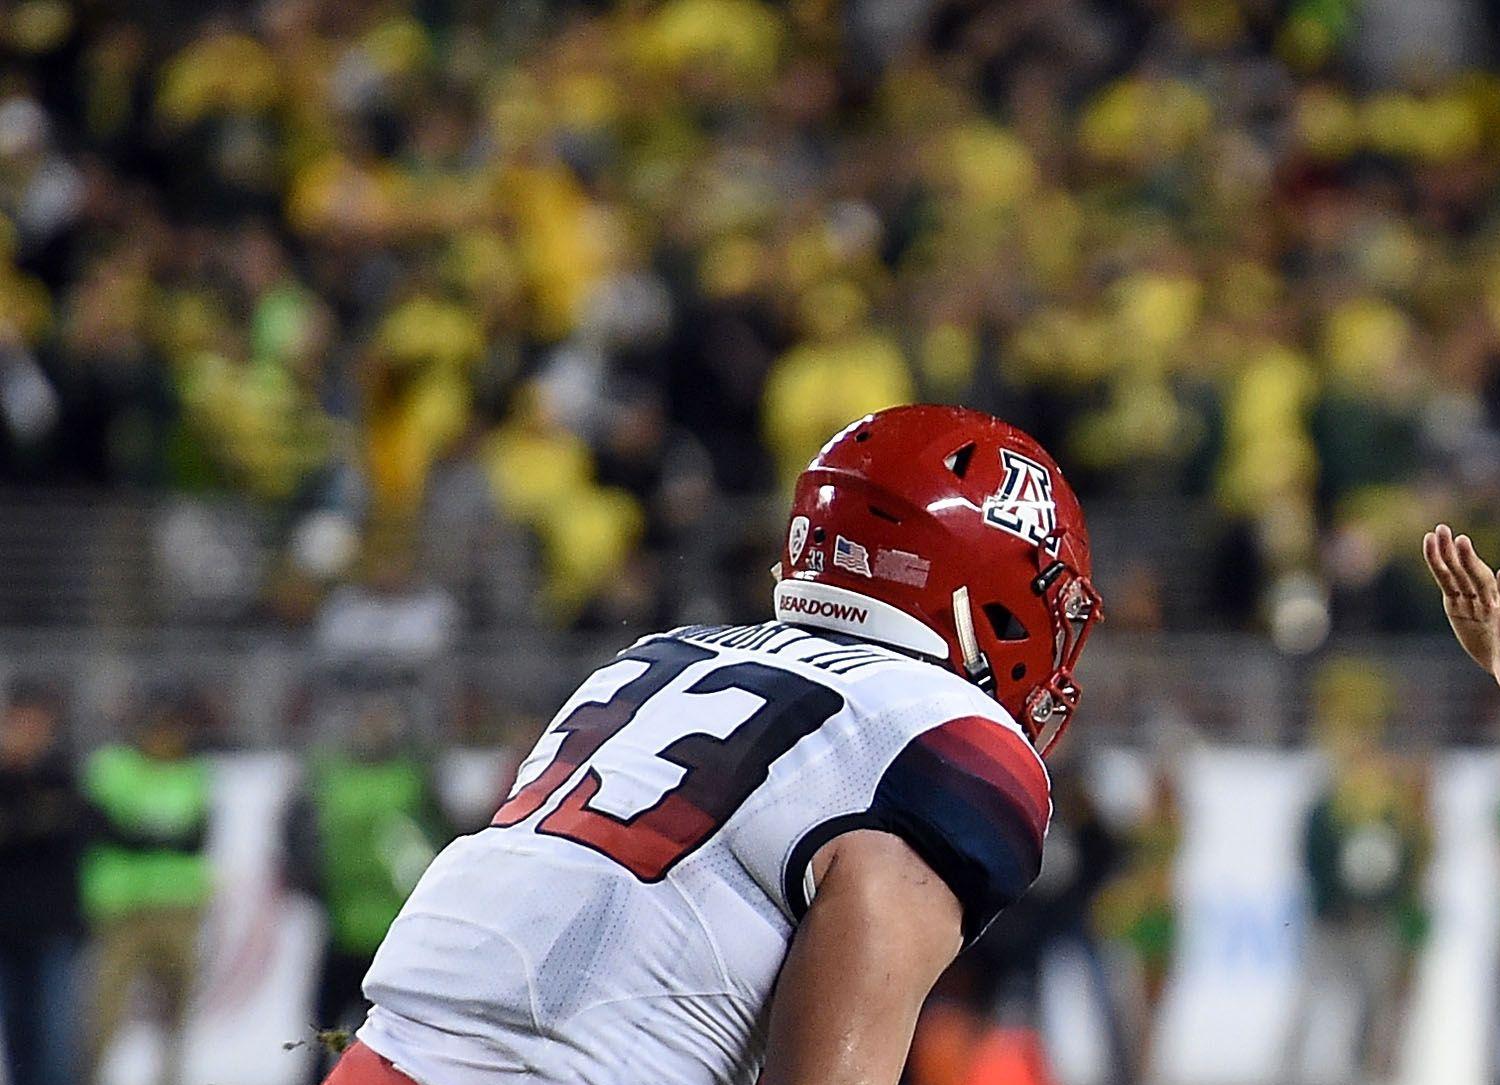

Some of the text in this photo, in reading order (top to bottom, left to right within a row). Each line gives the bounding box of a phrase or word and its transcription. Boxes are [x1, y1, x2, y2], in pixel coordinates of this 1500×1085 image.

[983, 447, 1061, 560] A
[805, 549, 825, 572] 33
[779, 594, 868, 624] BEARDOWN
[490, 638, 847, 884] 33
